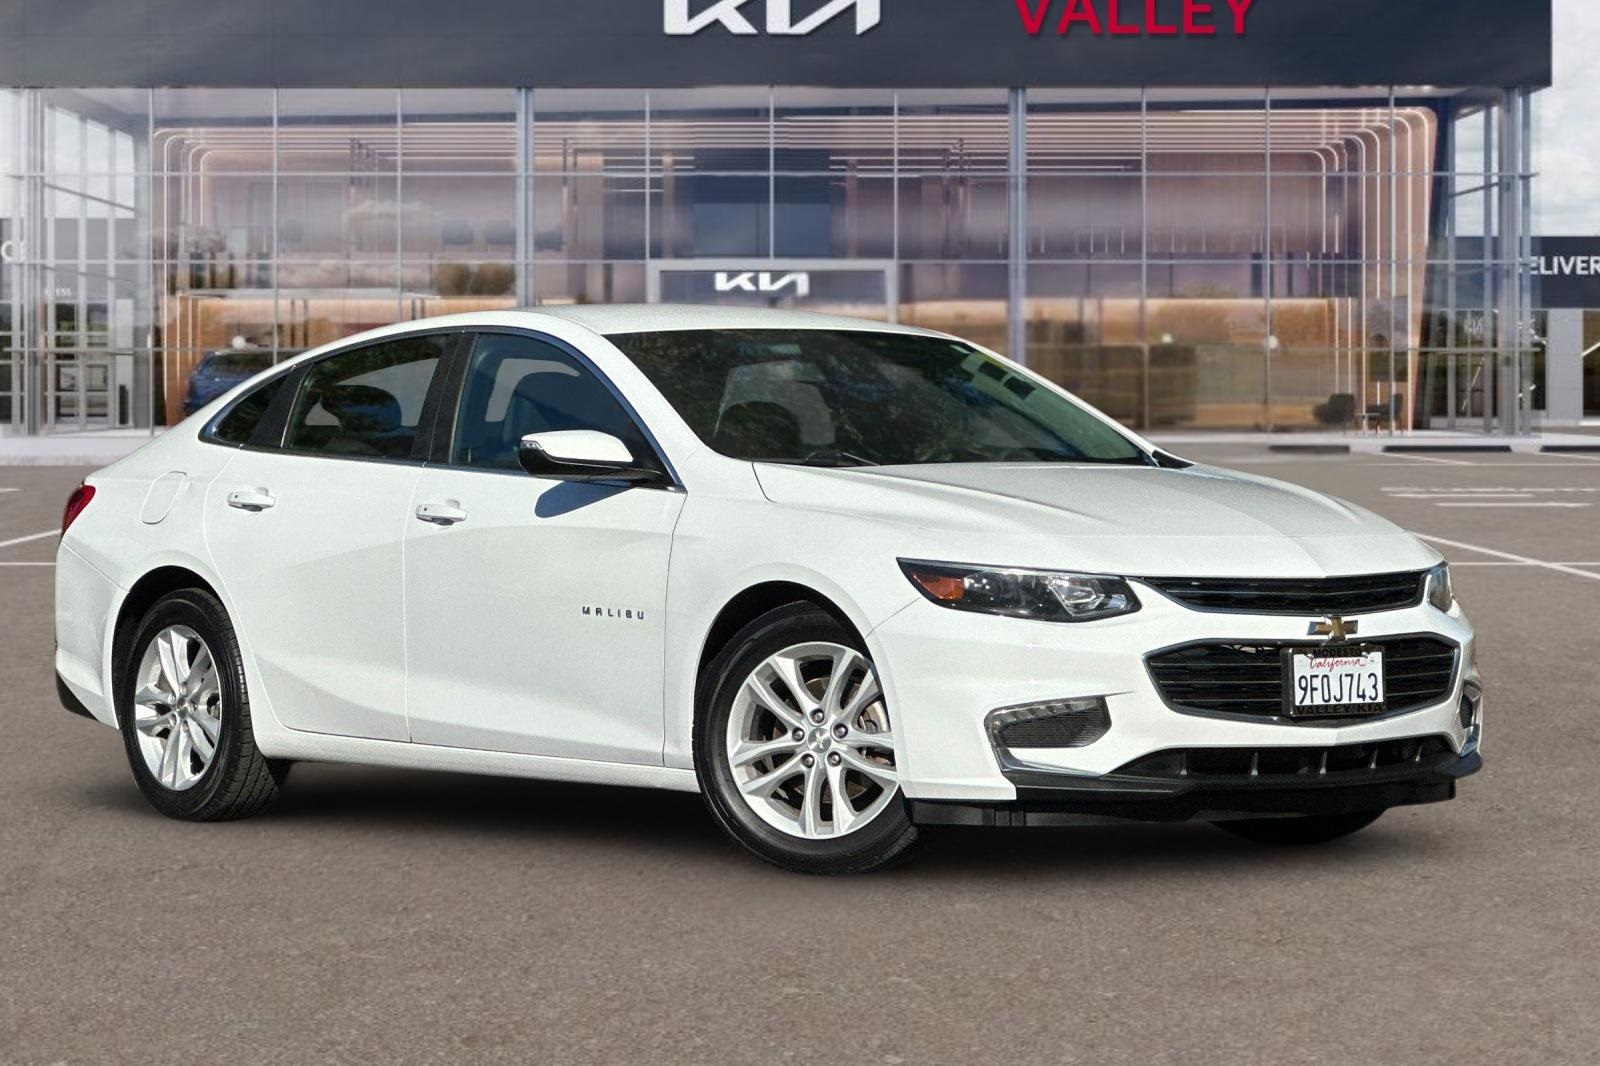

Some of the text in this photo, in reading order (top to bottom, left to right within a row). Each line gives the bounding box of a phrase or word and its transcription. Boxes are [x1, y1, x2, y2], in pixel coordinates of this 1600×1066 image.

[1015, 0, 1252, 35] VALLEY
[582, 606, 644, 619] MALIBU
[1309, 657, 1366, 672] California
[1297, 703, 1384, 715] VALLEY KIA
